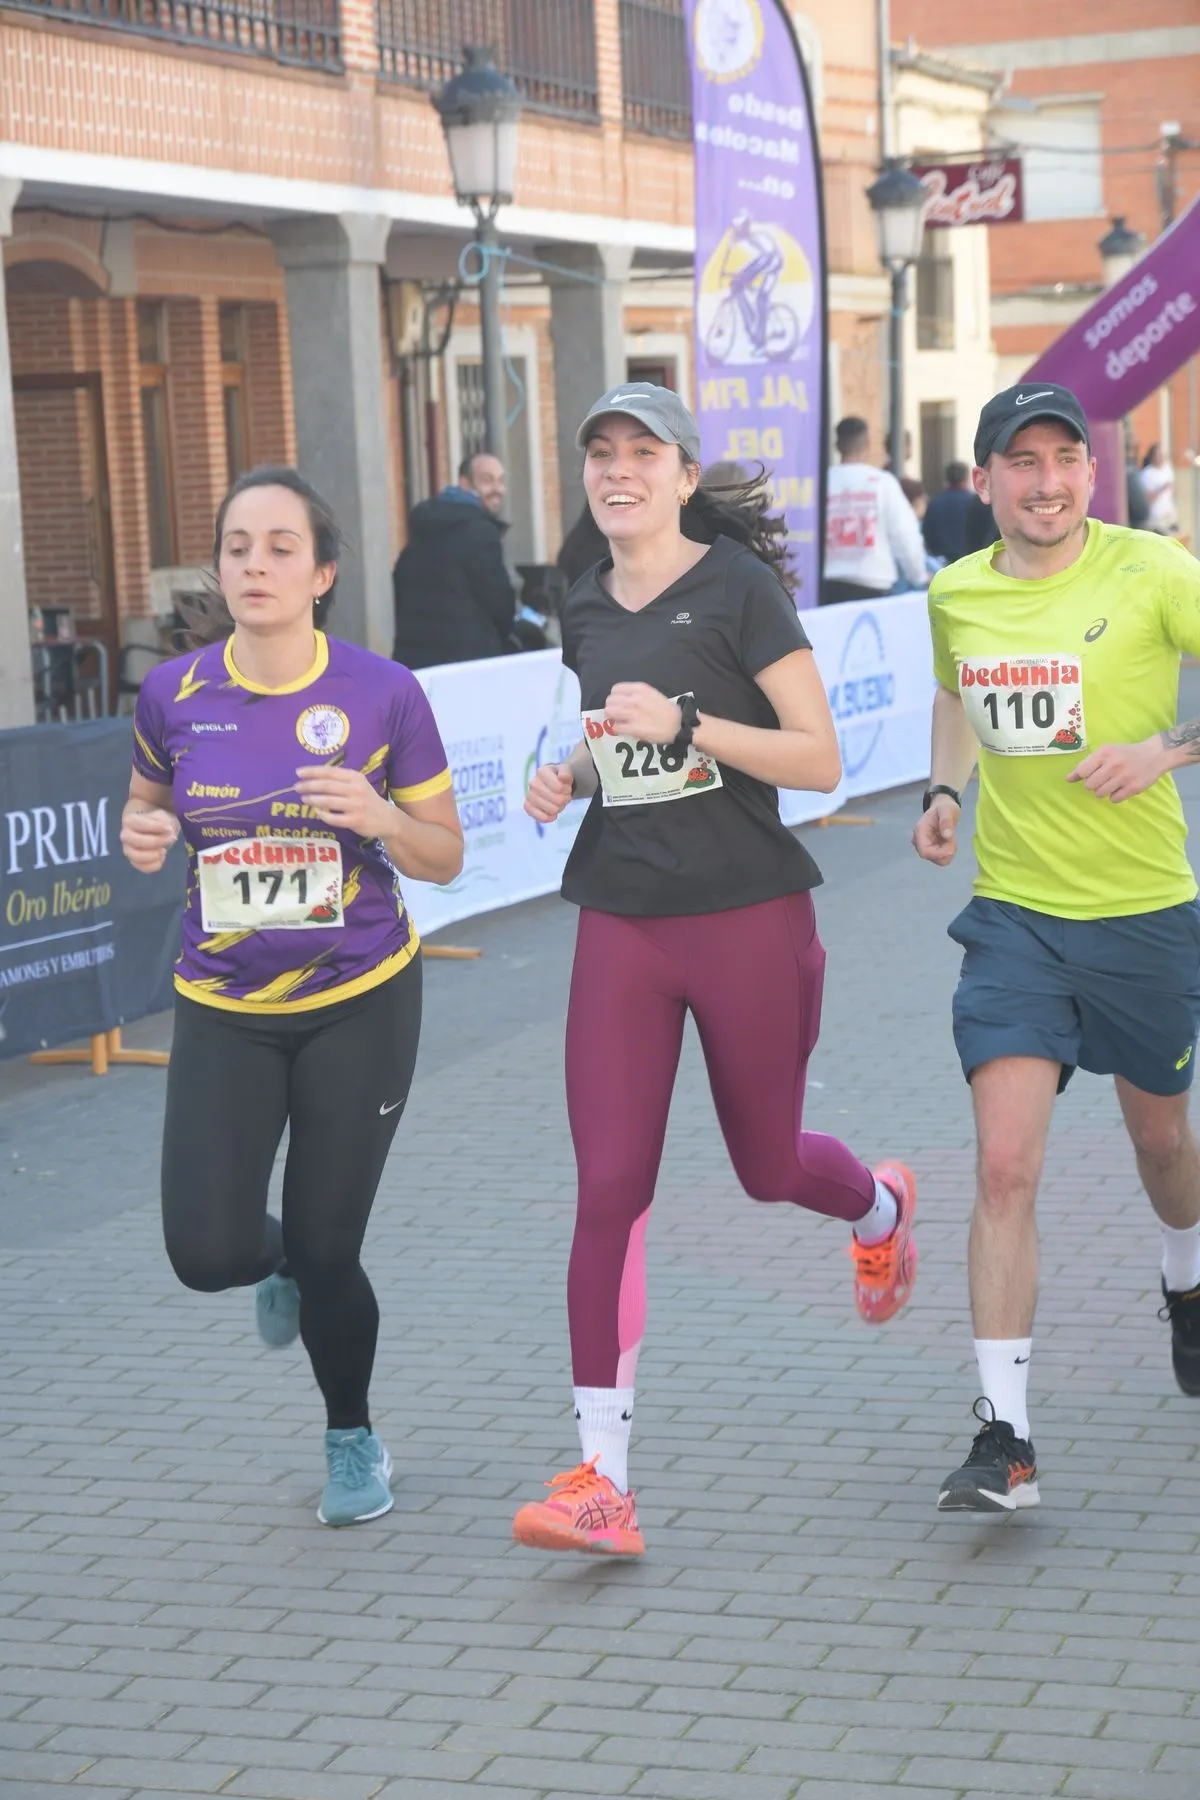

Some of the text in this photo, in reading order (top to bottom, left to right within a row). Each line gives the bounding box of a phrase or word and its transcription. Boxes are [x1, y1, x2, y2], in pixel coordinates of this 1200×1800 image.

[1083, 272, 1158, 350] somos
[1105, 291, 1198, 380] deporte
[961, 660, 1079, 688] bedunia
[983, 690, 1055, 730] 110
[186, 781, 241, 799] Jamón
[5, 797, 110, 875] PRIM
[255, 824, 337, 840] Macotera
[232, 868, 308, 905] 171
[6, 889, 47, 926] Oro
[50, 955, 60, 975] Y
